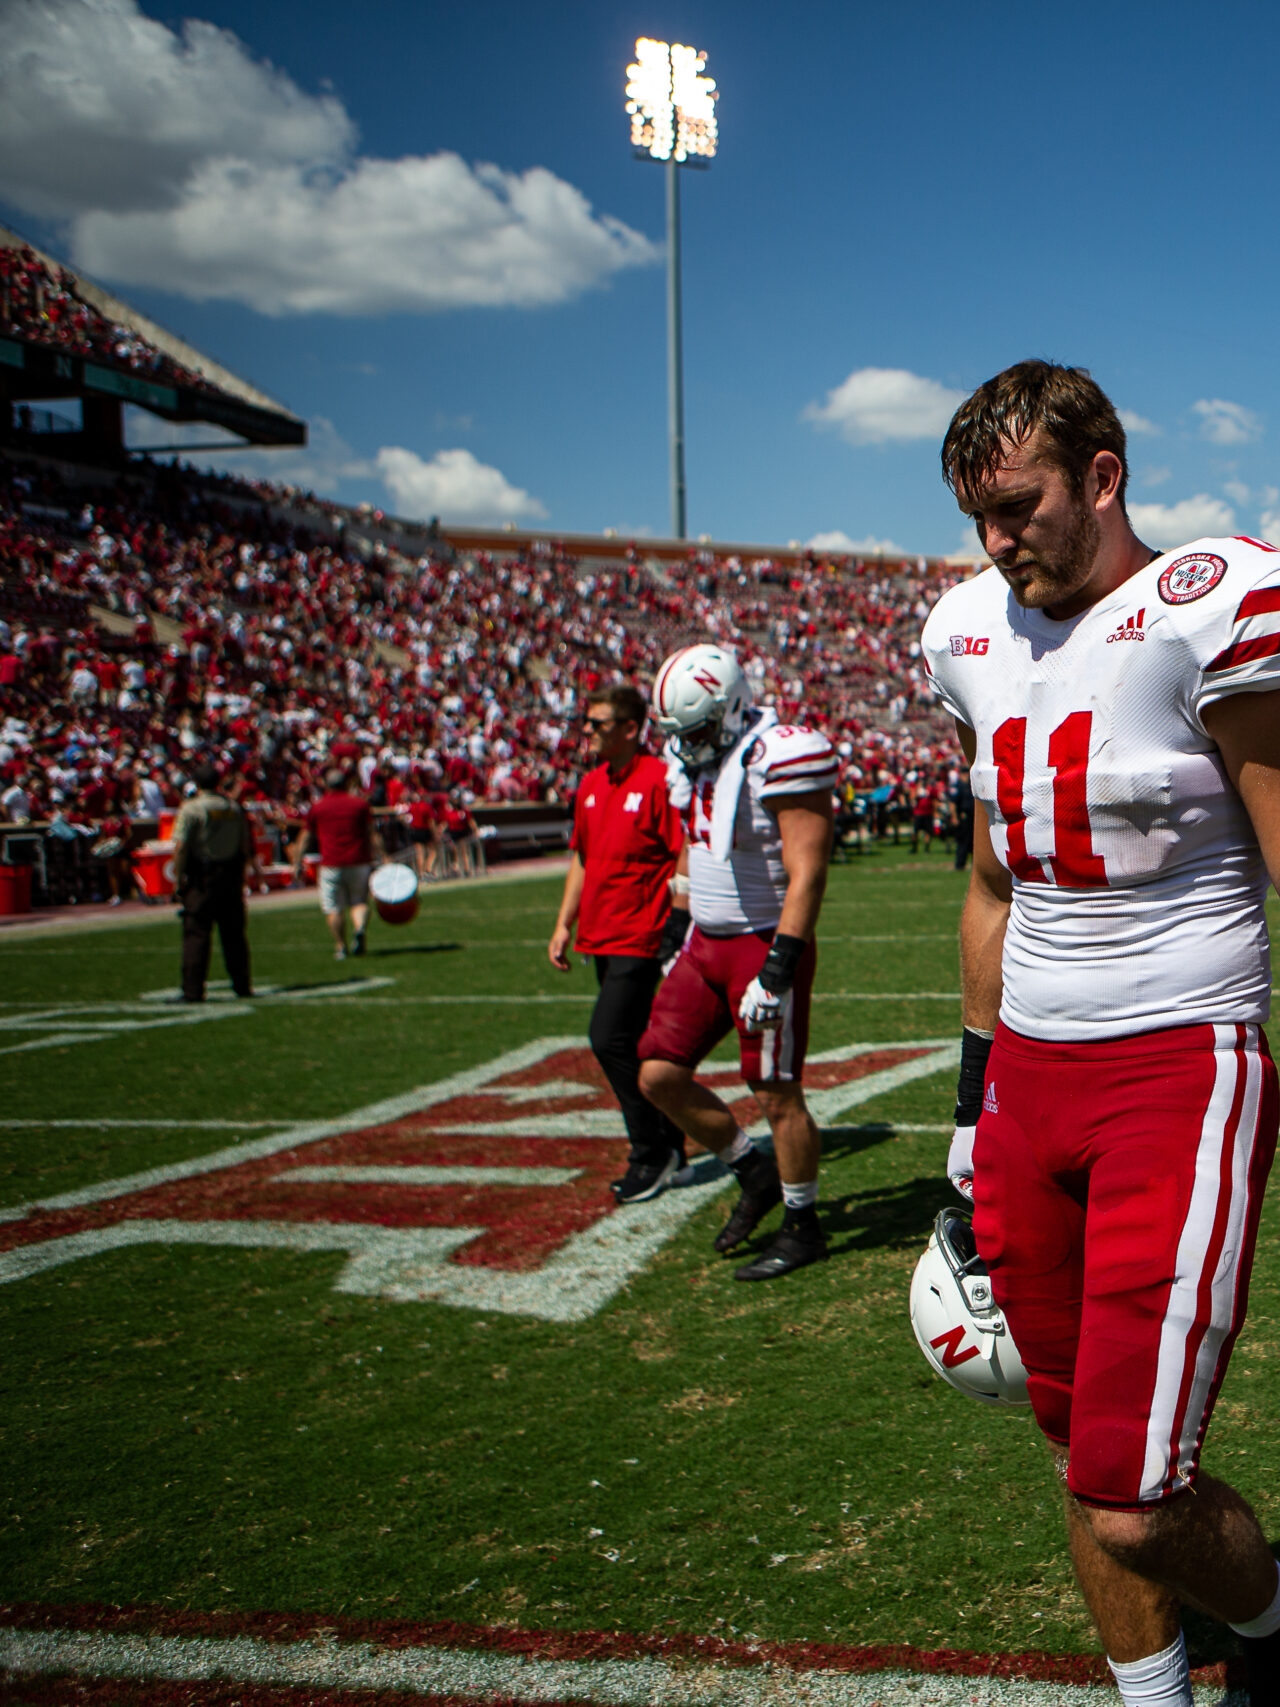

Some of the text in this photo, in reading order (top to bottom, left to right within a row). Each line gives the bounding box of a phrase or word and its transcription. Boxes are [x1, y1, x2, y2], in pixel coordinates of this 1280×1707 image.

[1174, 569, 1208, 583] HUSKERS
[1176, 584, 1212, 602] TRADITION
[1106, 627, 1146, 643] adidas
[694, 668, 721, 695] N
[623, 792, 643, 812] N
[992, 710, 1110, 888] 11
[929, 1324, 981, 1369] N
